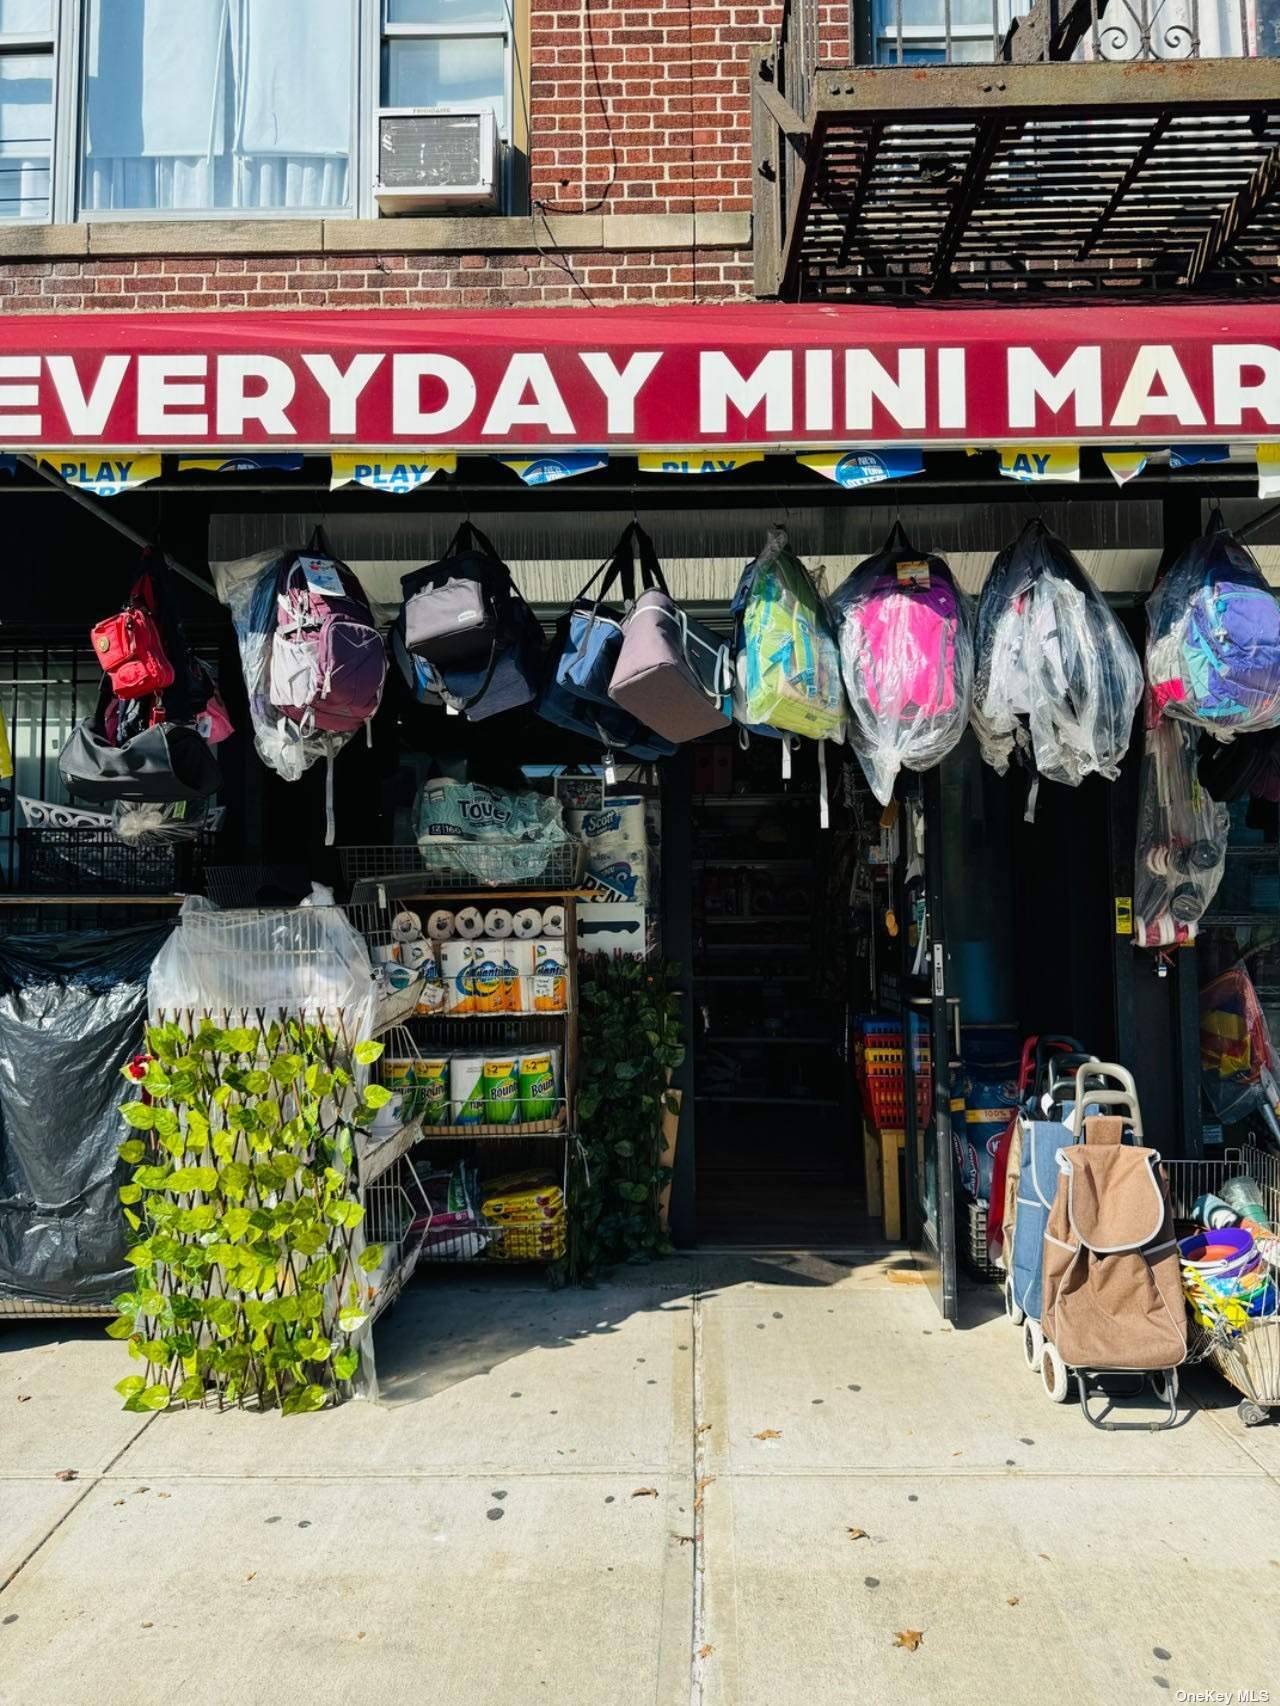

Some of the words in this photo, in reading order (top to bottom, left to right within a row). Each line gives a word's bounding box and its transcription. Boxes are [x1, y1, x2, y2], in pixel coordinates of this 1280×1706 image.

[0, 352, 663, 437] EVERYDAY
[699, 347, 966, 433] MINI
[60, 461, 133, 482] PLAY
[857, 456, 877, 466] NEW
[999, 453, 1051, 474] LAY
[354, 464, 428, 484] PLAY
